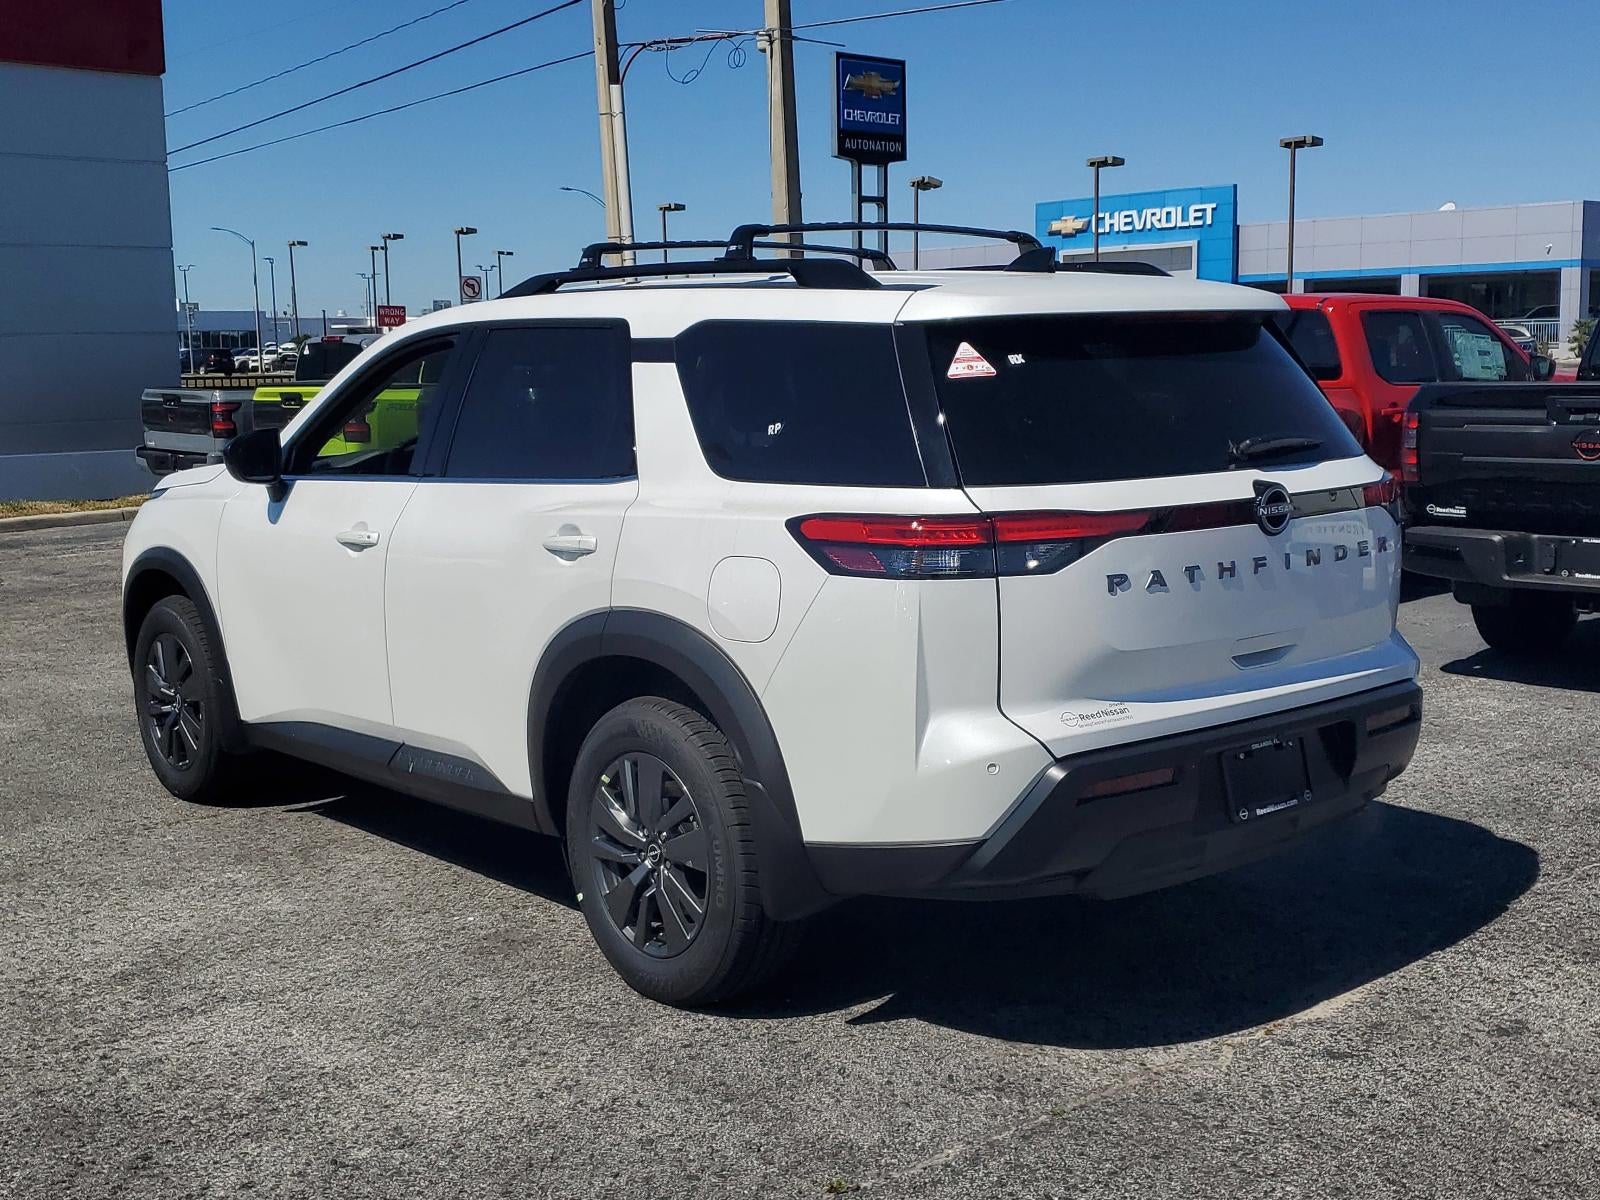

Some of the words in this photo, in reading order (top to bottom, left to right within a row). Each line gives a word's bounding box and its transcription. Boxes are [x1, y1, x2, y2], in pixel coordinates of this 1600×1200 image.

[844, 108, 901, 125] CHEVROLET
[844, 138, 902, 153] AUTONATION
[1092, 203, 1216, 234] CHEVROLET
[379, 308, 405, 316] WRONG
[384, 317, 400, 325] WAY
[767, 422, 782, 436] RP
[1106, 536, 1389, 597] PATHFINDER
[1079, 706, 1130, 722] ReedNissan
